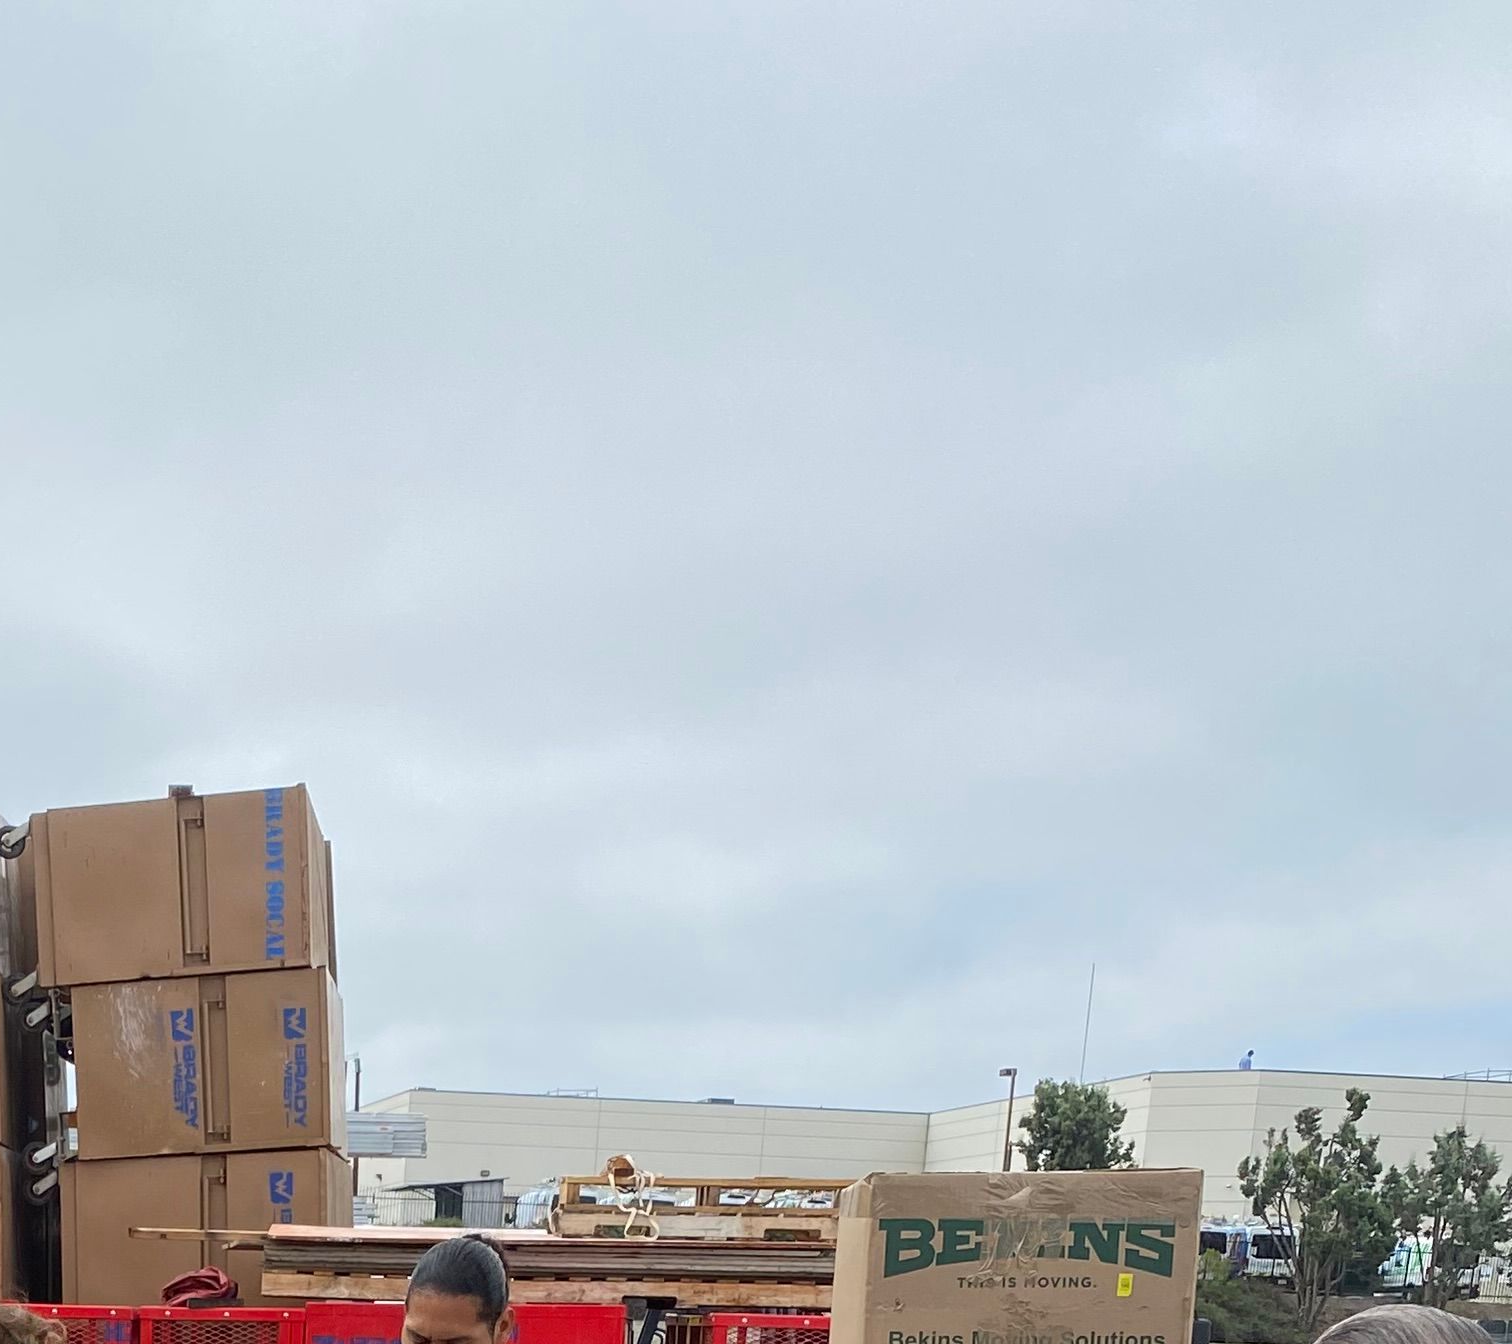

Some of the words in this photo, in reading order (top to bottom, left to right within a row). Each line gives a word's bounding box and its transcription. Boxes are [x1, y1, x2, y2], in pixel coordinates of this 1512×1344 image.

[264, 788, 285, 873] BRADY
[265, 880, 286, 960] SOCAL
[173, 1063, 188, 1113] WEST
[183, 1044, 199, 1128] BRADY
[283, 1061, 294, 1112] WEST
[294, 1044, 308, 1127] BRADY
[879, 1217, 1176, 1279] BENS
[1001, 1276, 1017, 1289] IS
